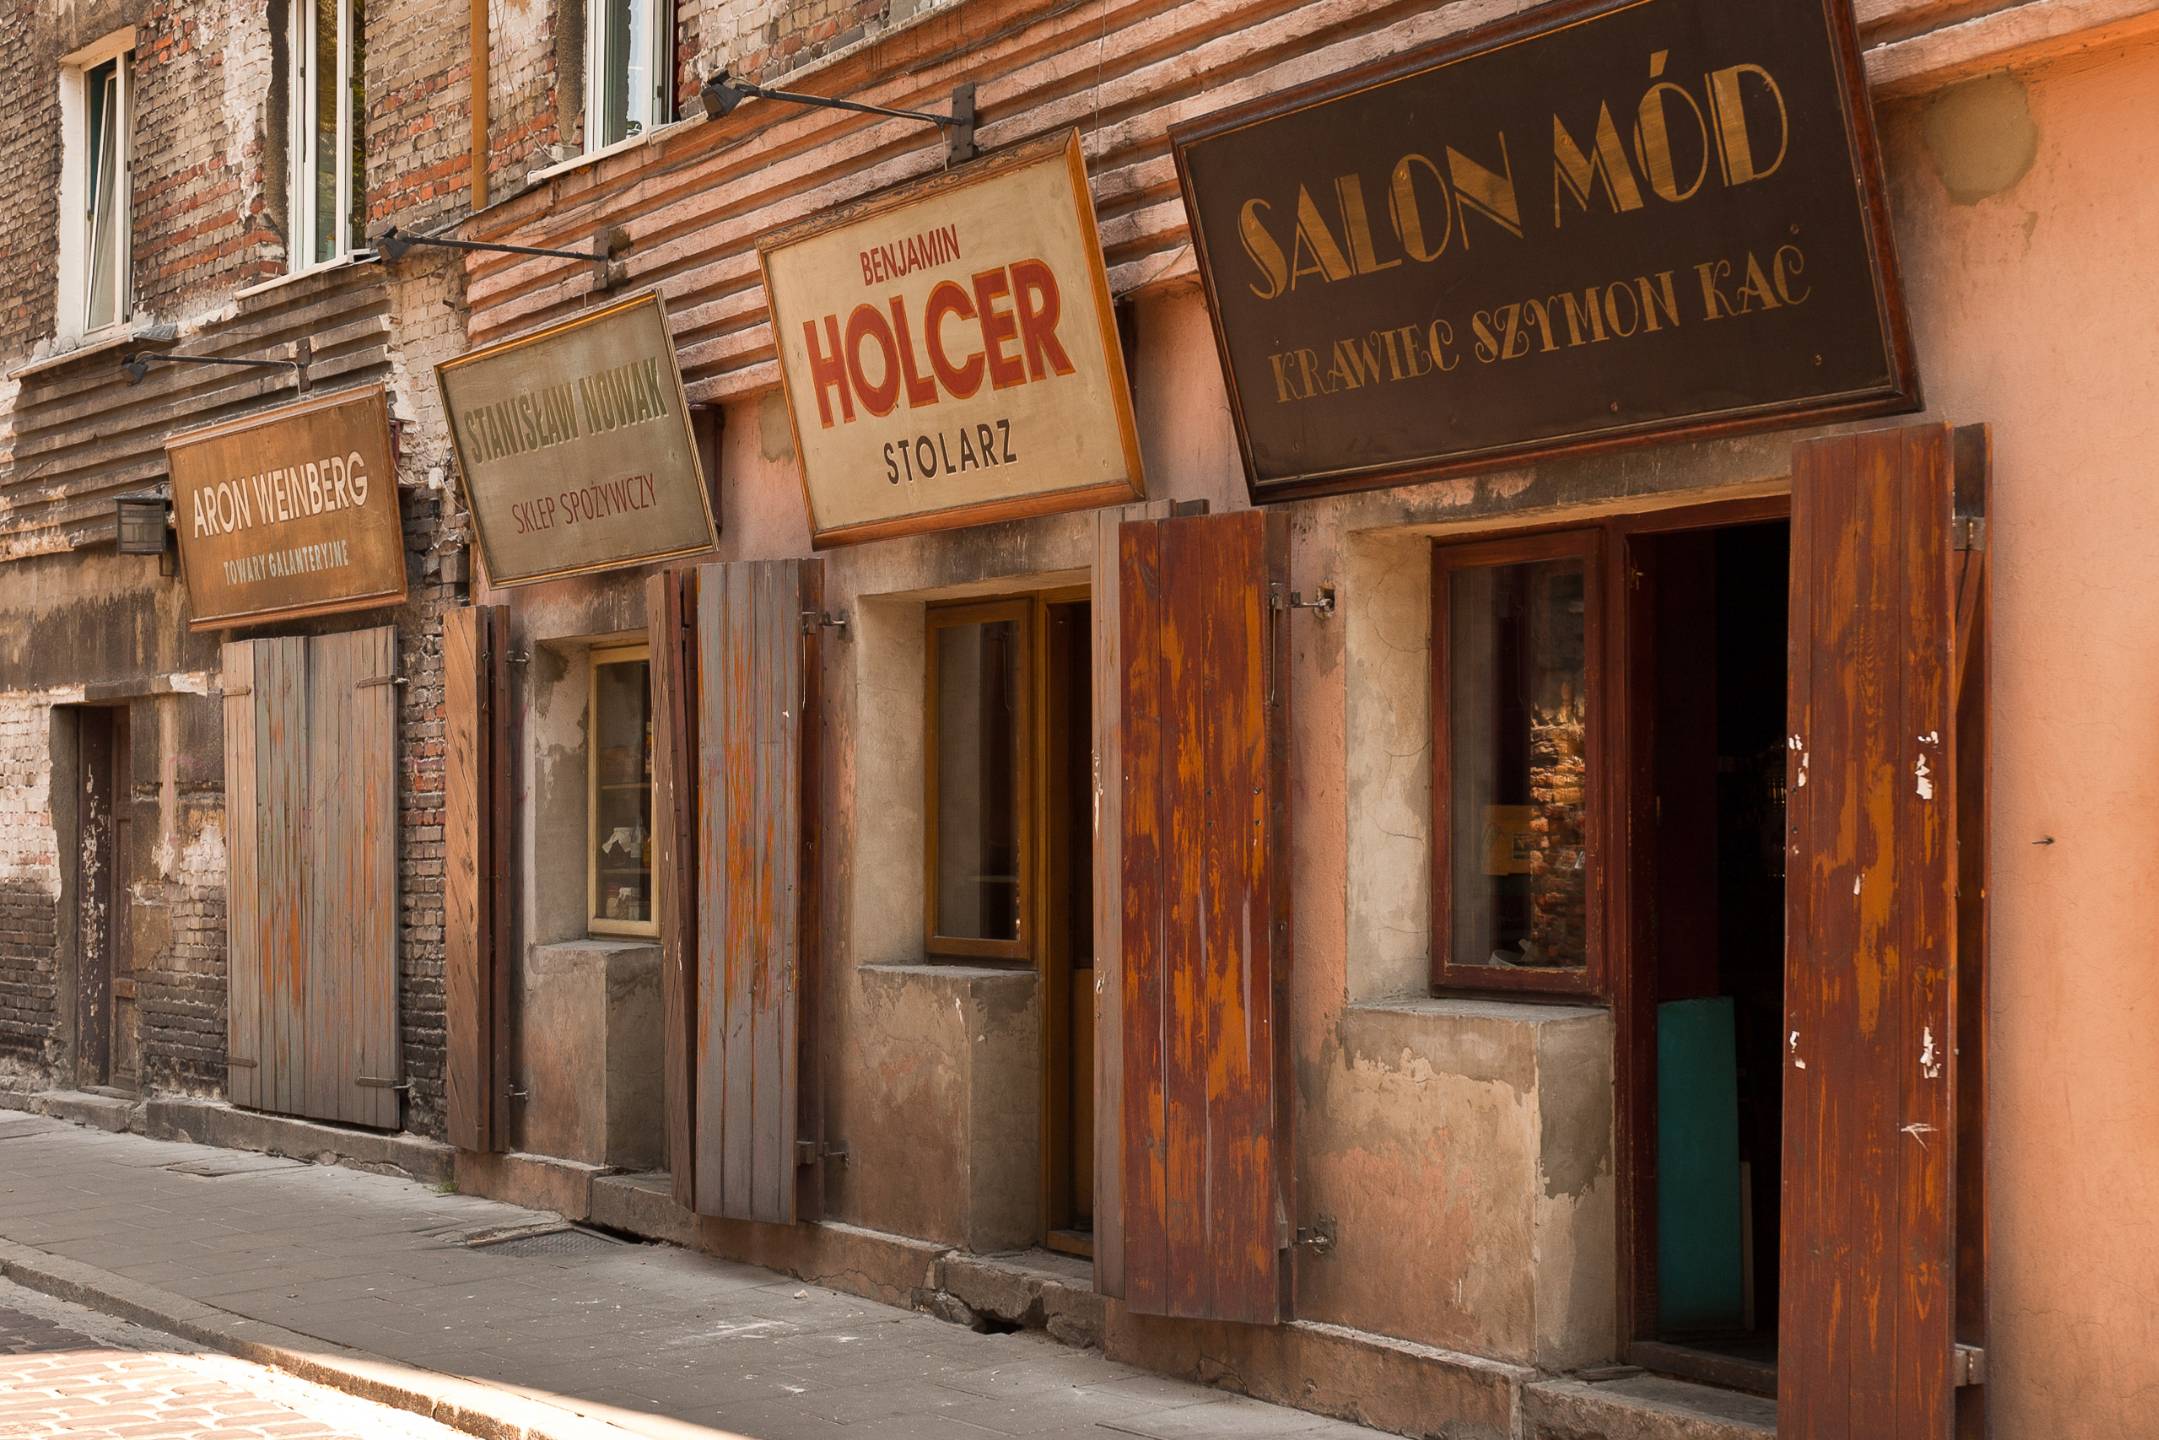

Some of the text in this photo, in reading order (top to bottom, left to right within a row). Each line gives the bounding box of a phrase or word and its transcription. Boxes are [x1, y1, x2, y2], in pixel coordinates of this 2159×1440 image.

[1238, 49, 1790, 300] SALON MÓD
[859, 223, 961, 287] BENJAMIN
[802, 257, 1077, 430] HOLCER
[1267, 244, 1812, 404] KRAWIEC SZYMON KAC
[463, 356, 670, 465] STANISŁAW NOWAK
[883, 418, 1019, 486] STOLARZ
[193, 451, 368, 538] ARON WEINBERG
[511, 472, 657, 535] SKLEP SPOŻYWCZY
[223, 540, 349, 586] TOWARY GALANTERYJNE
